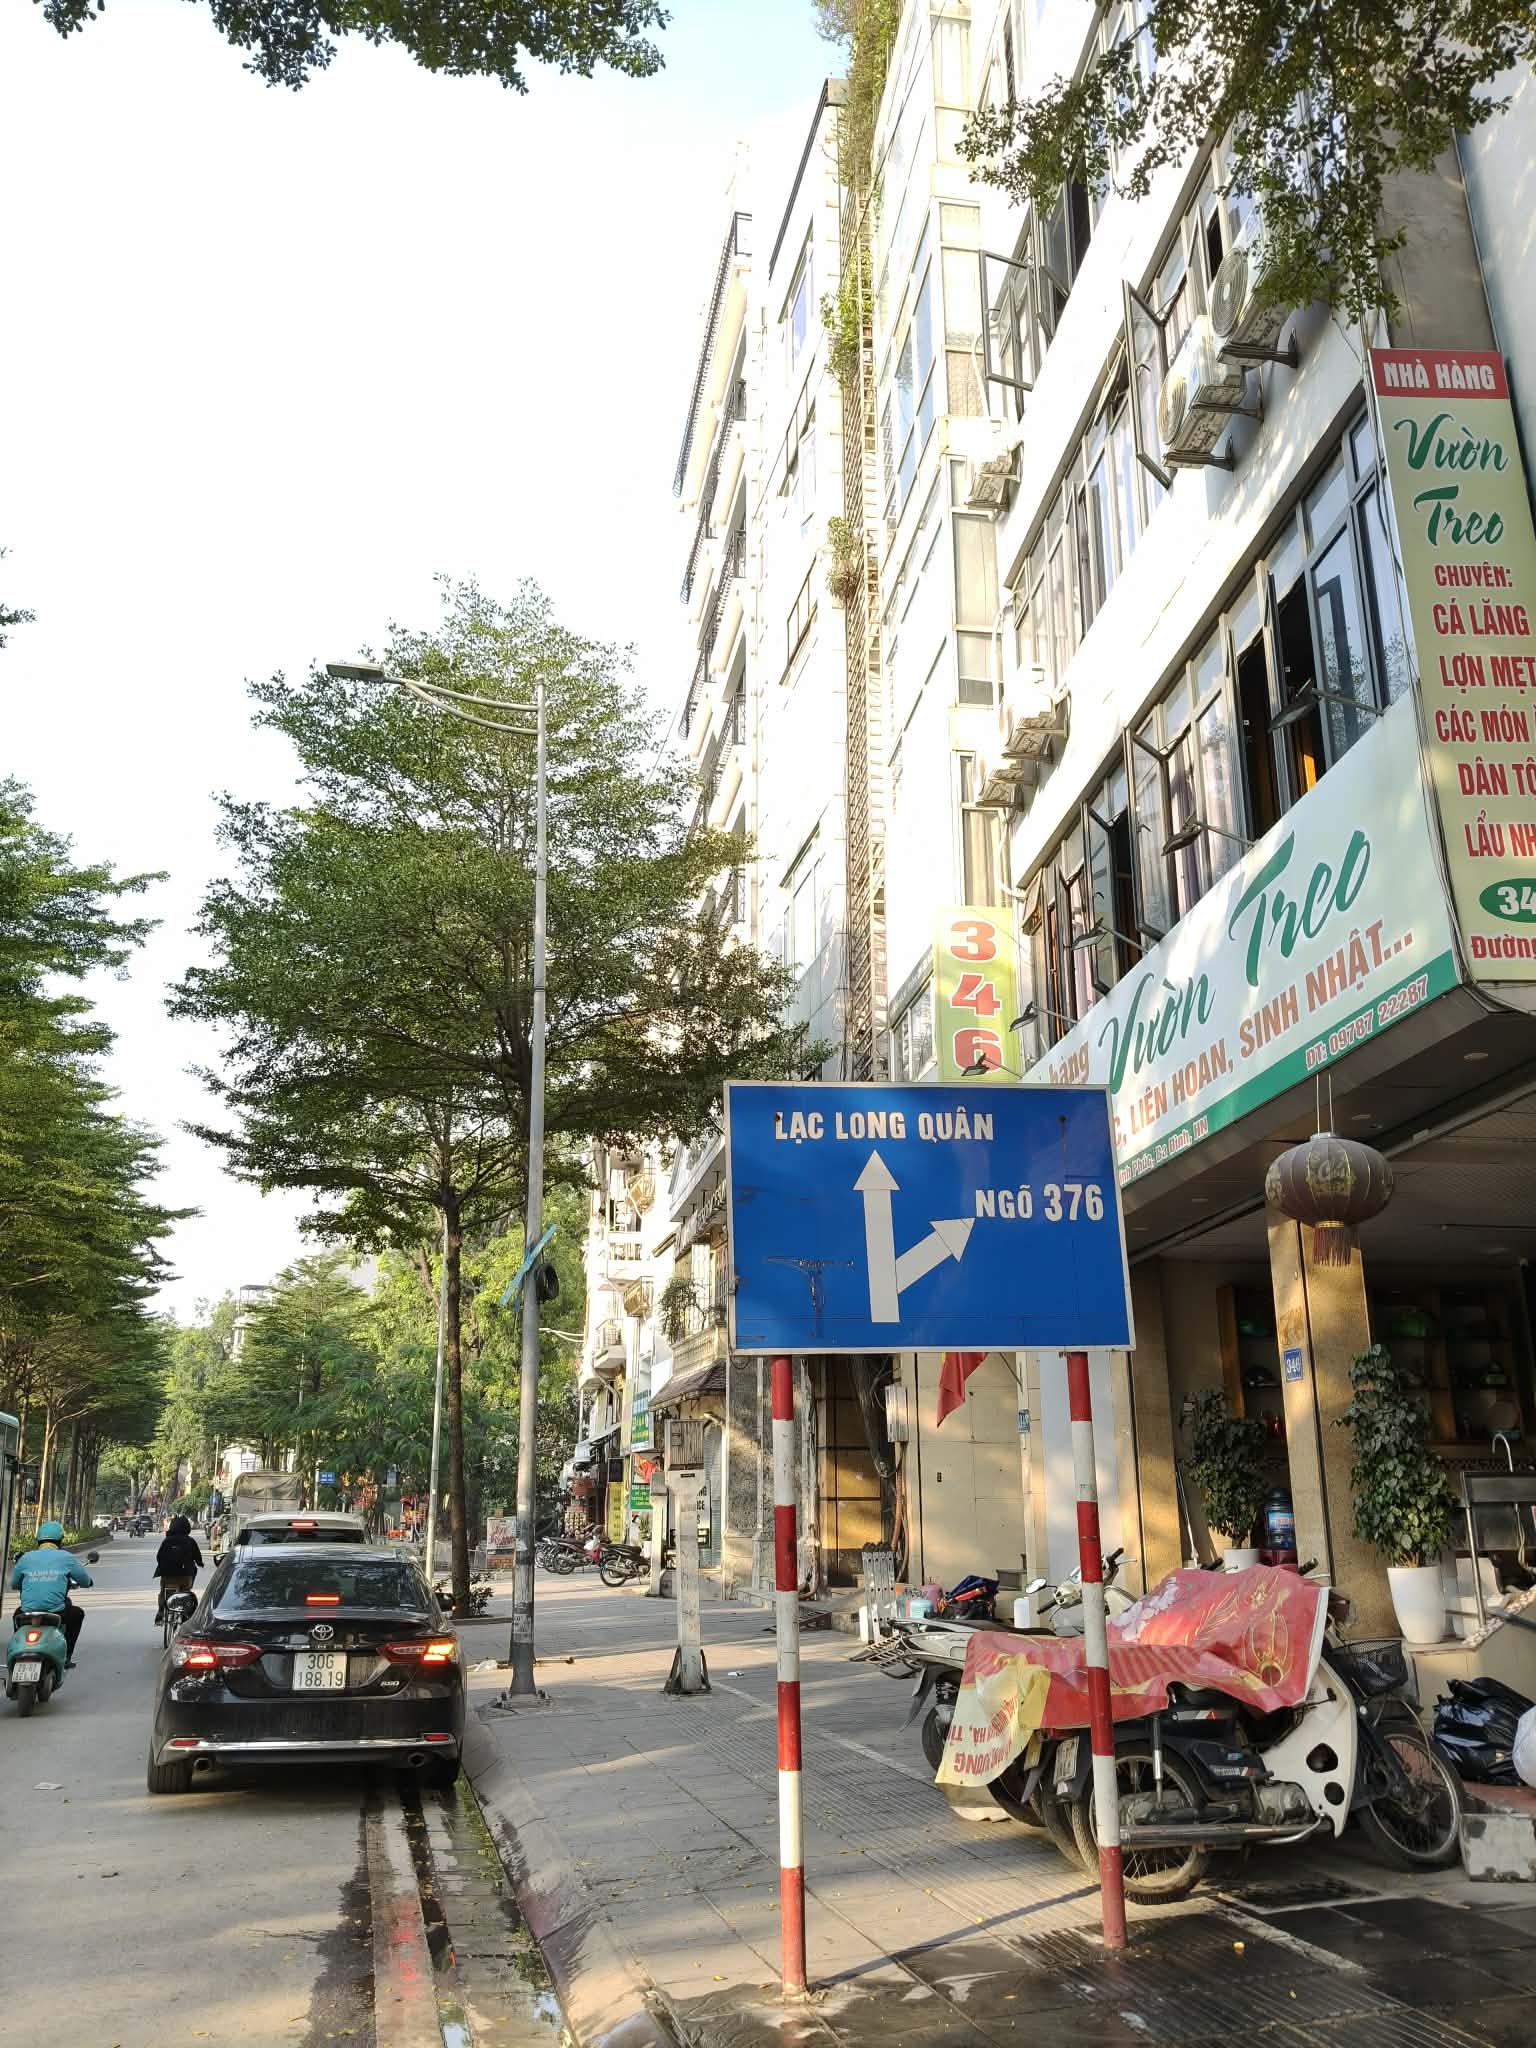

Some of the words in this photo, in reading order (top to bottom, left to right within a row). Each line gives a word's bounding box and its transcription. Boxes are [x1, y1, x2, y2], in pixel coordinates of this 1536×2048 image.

[1383, 359, 1430, 388] NHÀ
[1434, 360, 1496, 390] HÀNG
[1413, 485, 1504, 546] Treo
[1434, 562, 1513, 587] CHUYÊN:
[1432, 598, 1466, 634] CÁ
[1468, 598, 1530, 635] LĂNG
[1439, 652, 1486, 694] LỢN
[1490, 656, 1536, 694] MẸT
[1435, 704, 1477, 742] CÁC
[1480, 704, 1530, 743] MÓN
[1458, 756, 1509, 795] DÂN
[1464, 809, 1505, 857] LẨU
[1228, 830, 1371, 987] Treo
[1329, 1010, 1374, 1054] 09787
[1378, 974, 1428, 1025] 22287
[1130, 1082, 1167, 1135] LIÊN
[1172, 1038, 1233, 1106] HOAN,
[1239, 984, 1299, 1058] SINH
[775, 1112, 824, 1143] LẠC
[835, 1111, 906, 1140] LONG
[918, 1105, 994, 1143] QUÂN
[975, 1184, 1033, 1219] NGÕ
[1043, 1184, 1104, 1221] 376
[299, 1671, 344, 1687] 188.19
[307, 1654, 334, 1670] 30G
